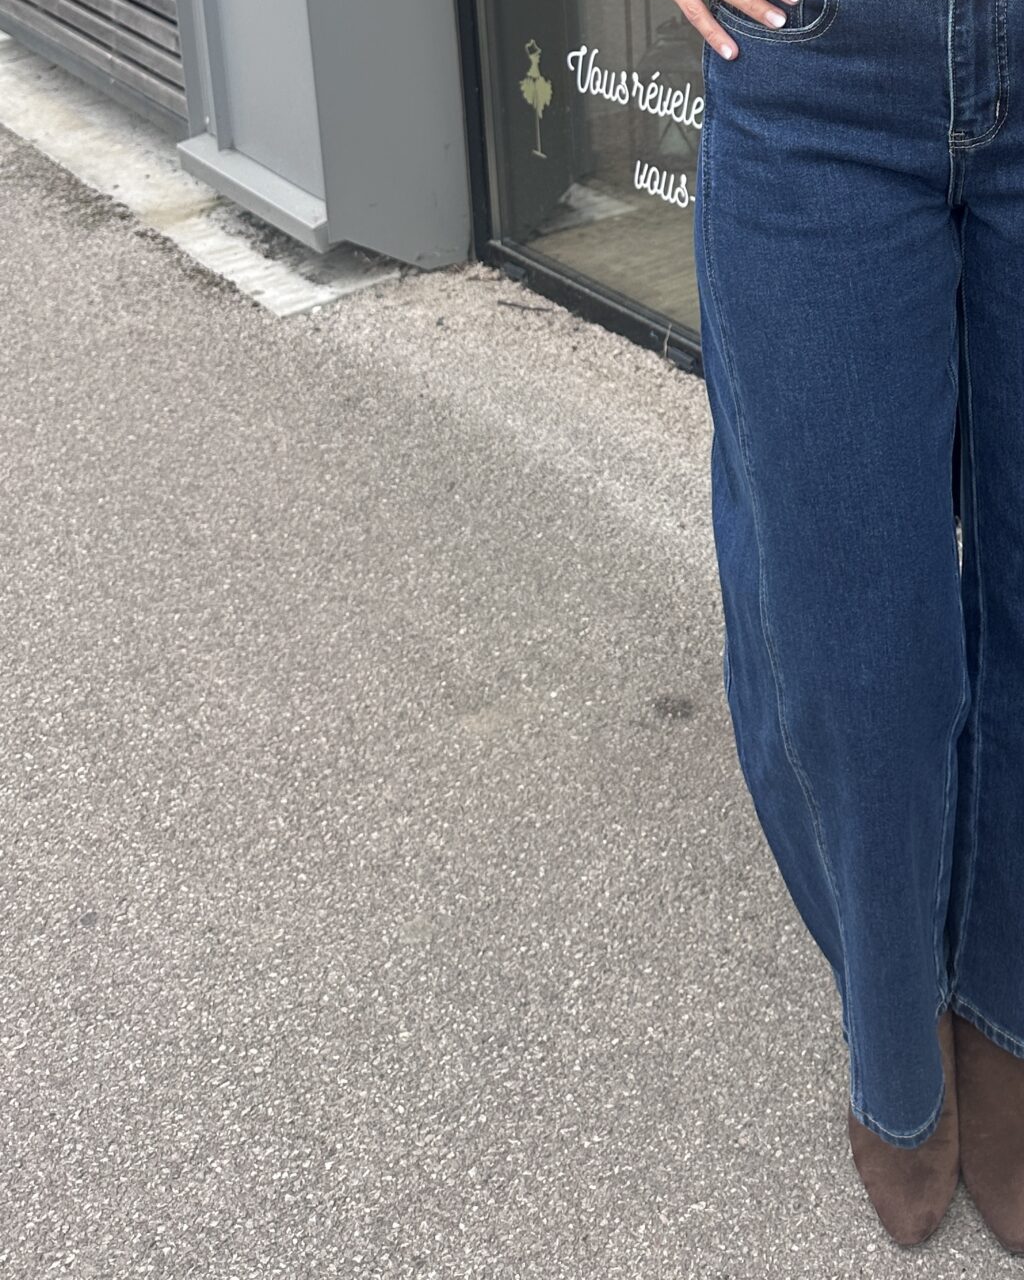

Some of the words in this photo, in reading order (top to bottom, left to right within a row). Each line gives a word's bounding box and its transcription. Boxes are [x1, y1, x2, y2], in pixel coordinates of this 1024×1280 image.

[566, 45, 629, 104] Vous
[632, 71, 705, 129] révele
[634, 160, 696, 208] vous-
